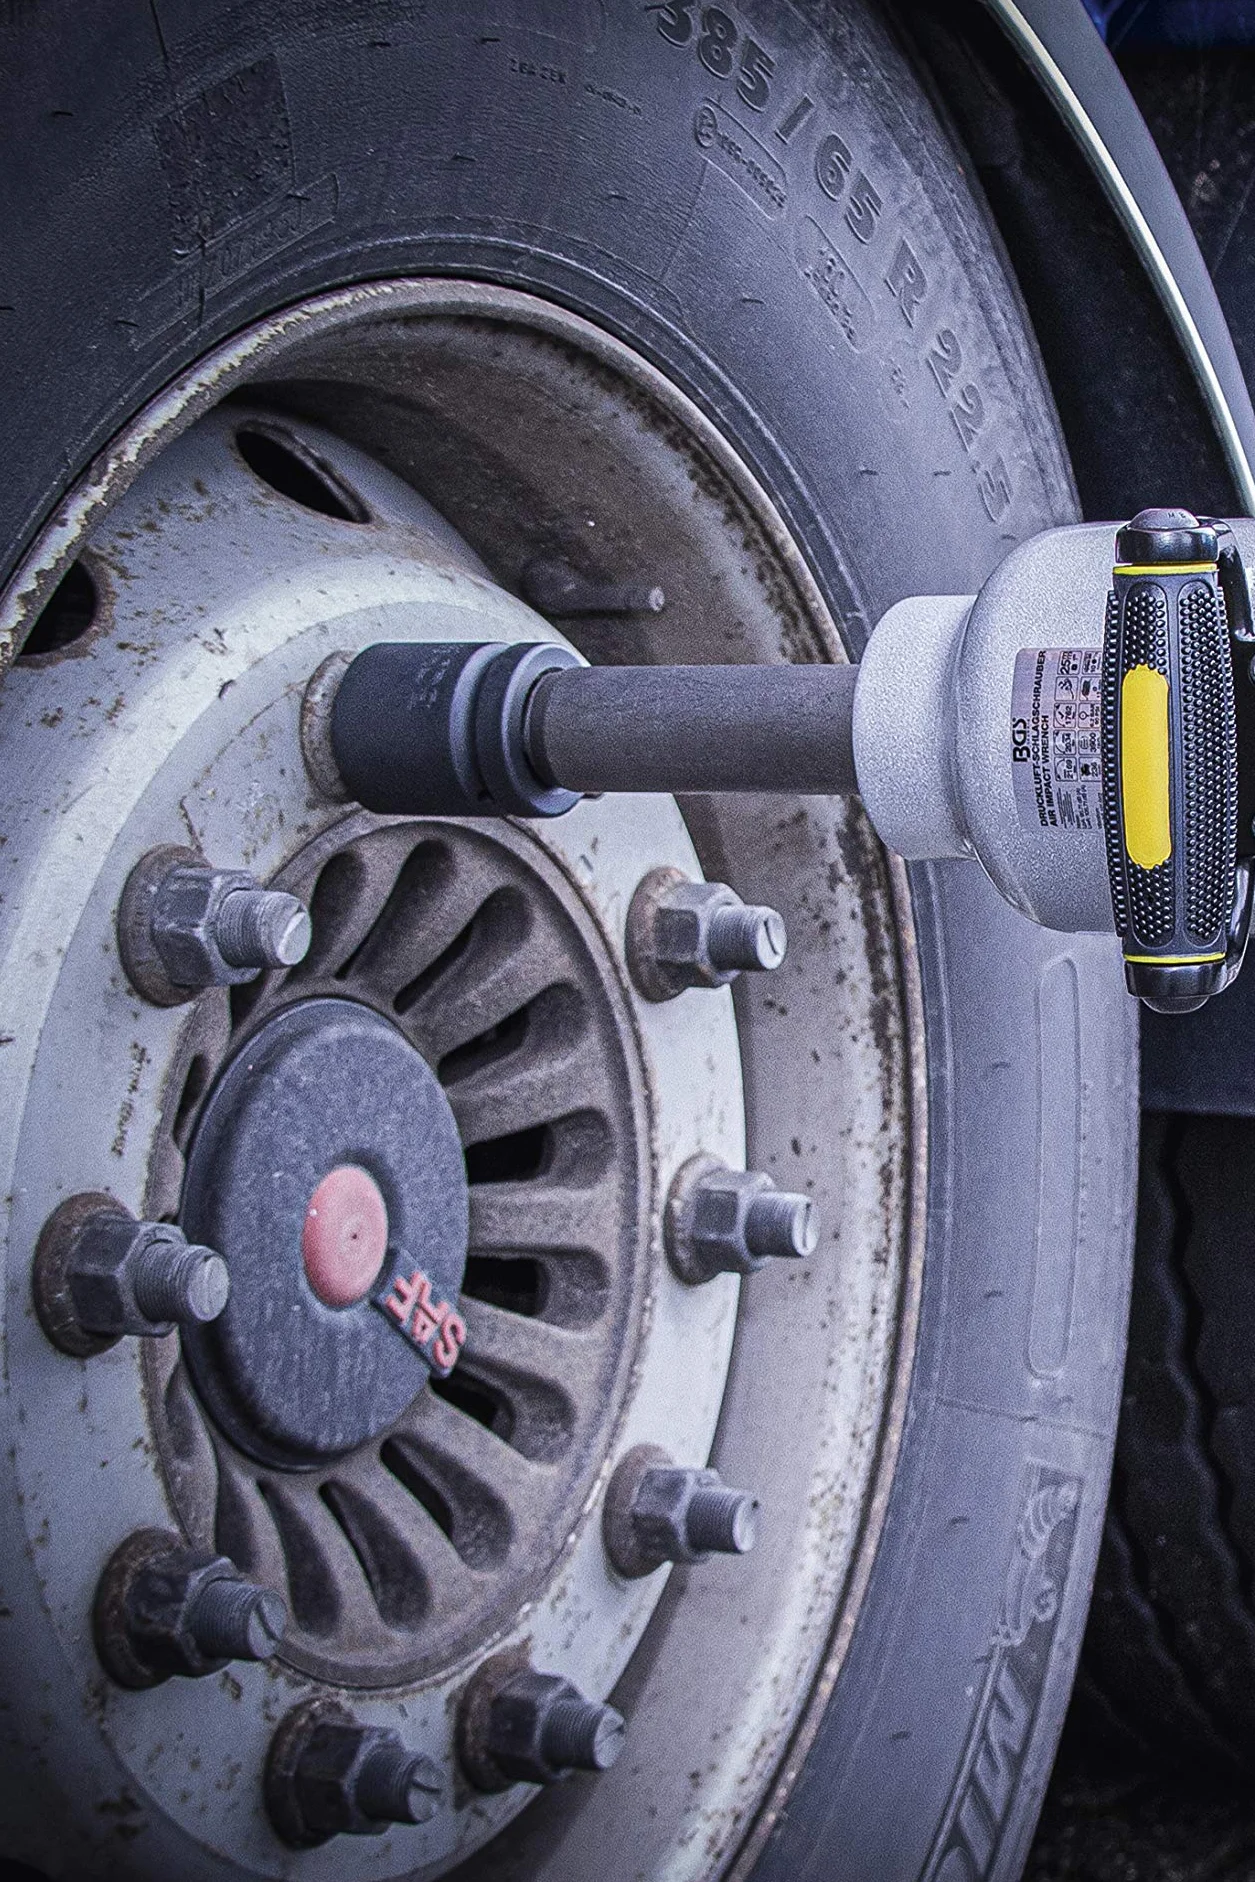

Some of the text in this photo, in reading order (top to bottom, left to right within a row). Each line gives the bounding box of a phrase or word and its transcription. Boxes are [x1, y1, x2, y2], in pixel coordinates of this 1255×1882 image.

[1031, 650, 1049, 827] DRUCKLUFT-SCHLAGSCHRAUBER
[1040, 715, 1058, 827] AIR IMPACT WRENCH
